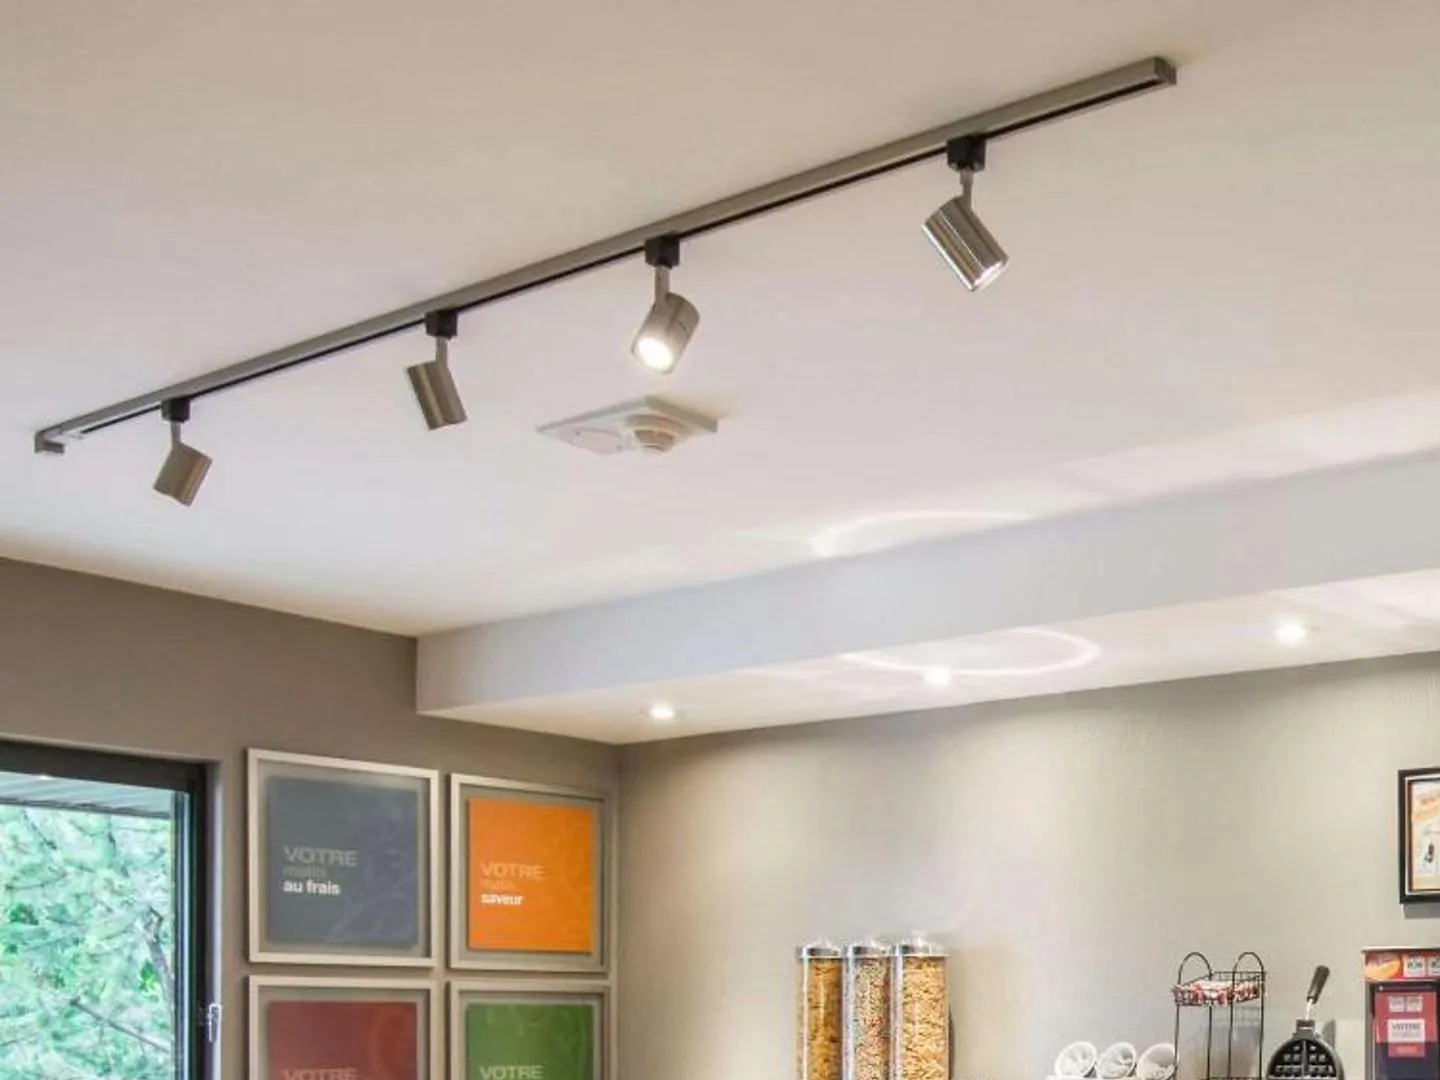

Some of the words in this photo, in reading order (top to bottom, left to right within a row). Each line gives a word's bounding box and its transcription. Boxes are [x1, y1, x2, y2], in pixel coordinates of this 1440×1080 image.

[282, 847, 359, 866] VOTRE
[480, 862, 546, 880] VOTRE
[283, 881, 303, 893] au
[306, 879, 341, 896] frais
[479, 1065, 544, 1080] VOTRE
